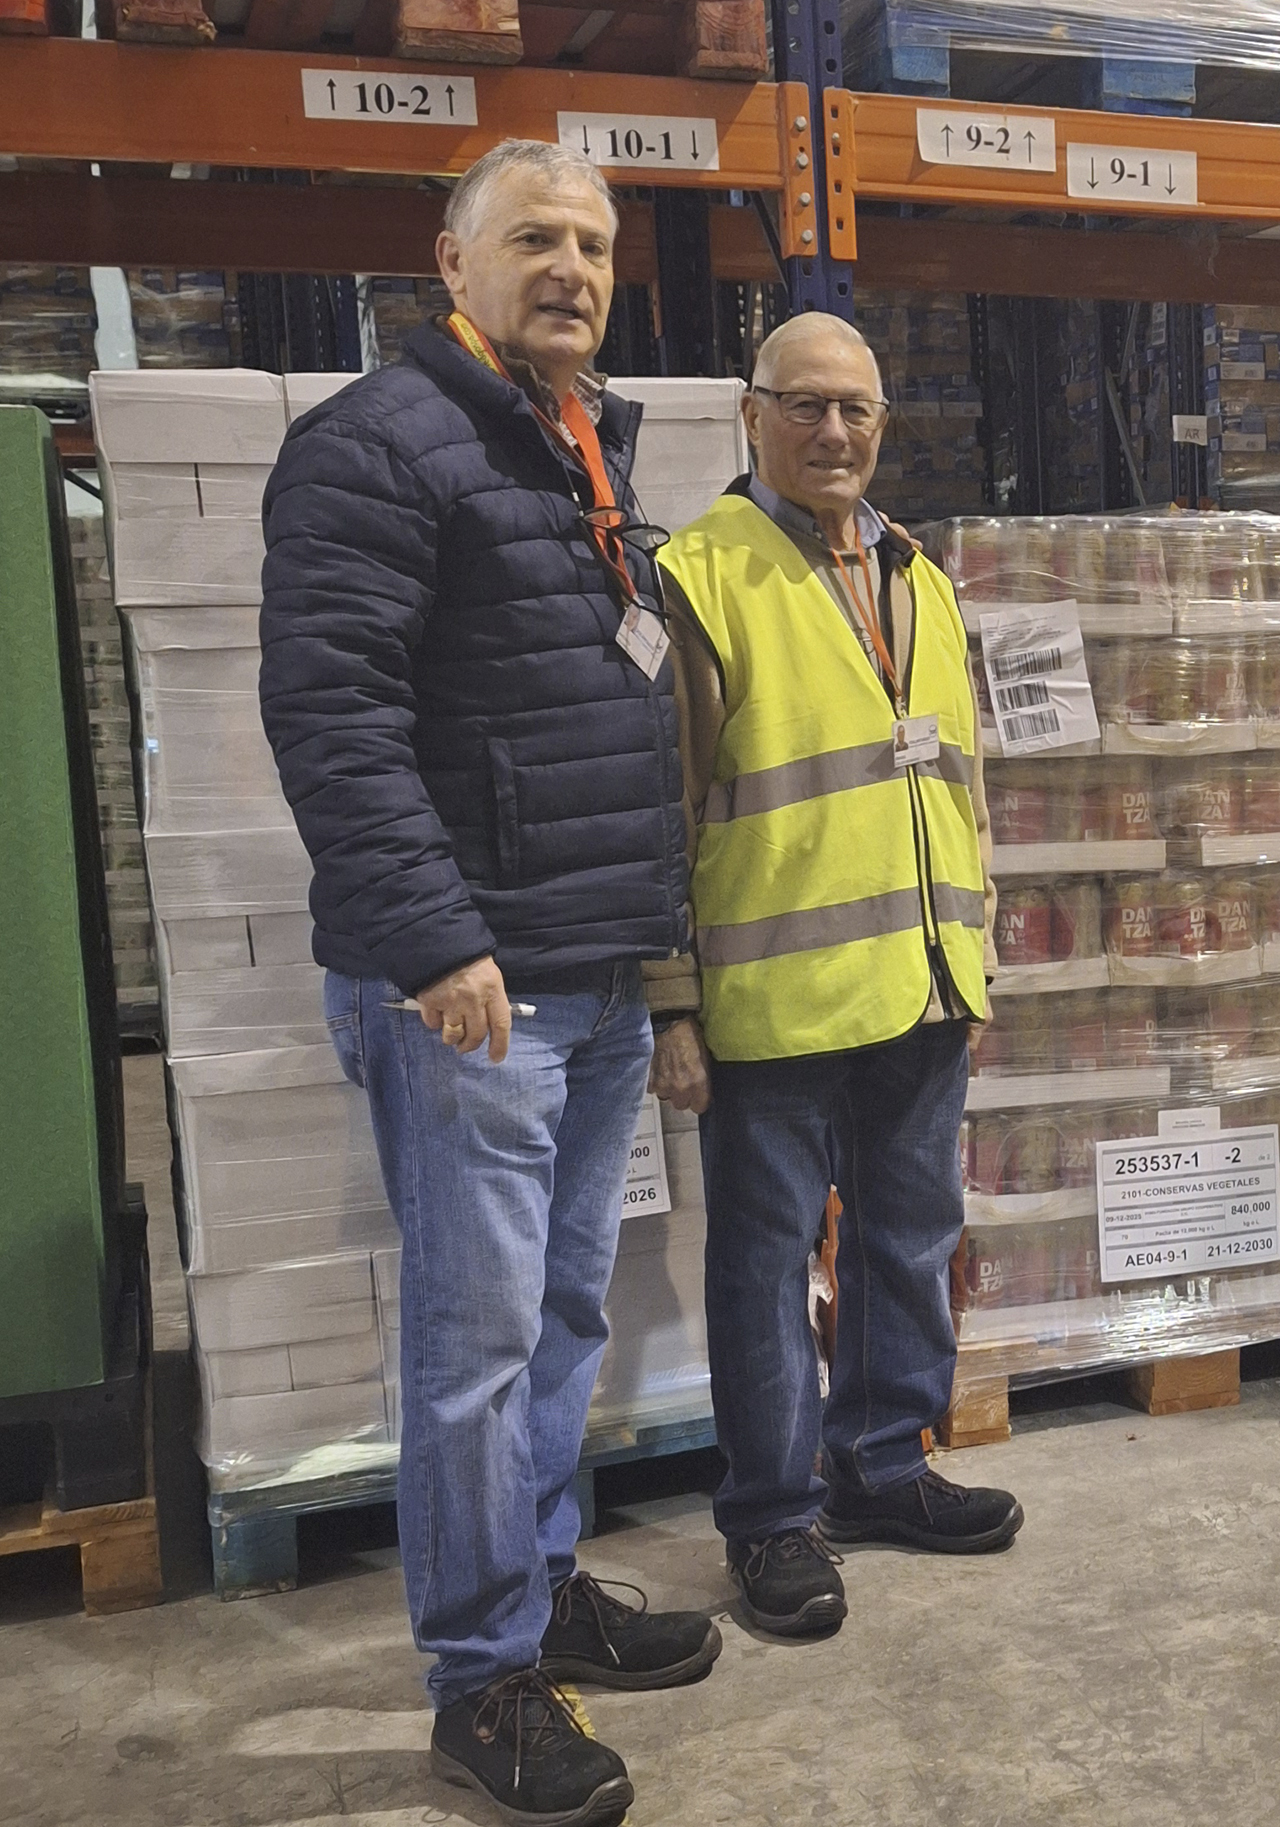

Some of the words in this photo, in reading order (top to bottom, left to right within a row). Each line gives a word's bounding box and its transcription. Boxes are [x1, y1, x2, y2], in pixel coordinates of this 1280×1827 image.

[353, 81, 432, 116] 10-2
[605, 127, 675, 161] 10-1
[965, 124, 1011, 154] 9-2
[1109, 157, 1151, 187] 9-1
[1184, 427, 1201, 441] AR
[1115, 1151, 1200, 1176] 253537-1
[1225, 1147, 1242, 1164] -2
[1121, 1183, 1205, 1200] 2101-CONSERVAS
[1207, 1177, 1261, 1192] VEGETALES
[1124, 1249, 1188, 1268] AE04-9-1
[1207, 1238, 1273, 1258] 21-12-2030
